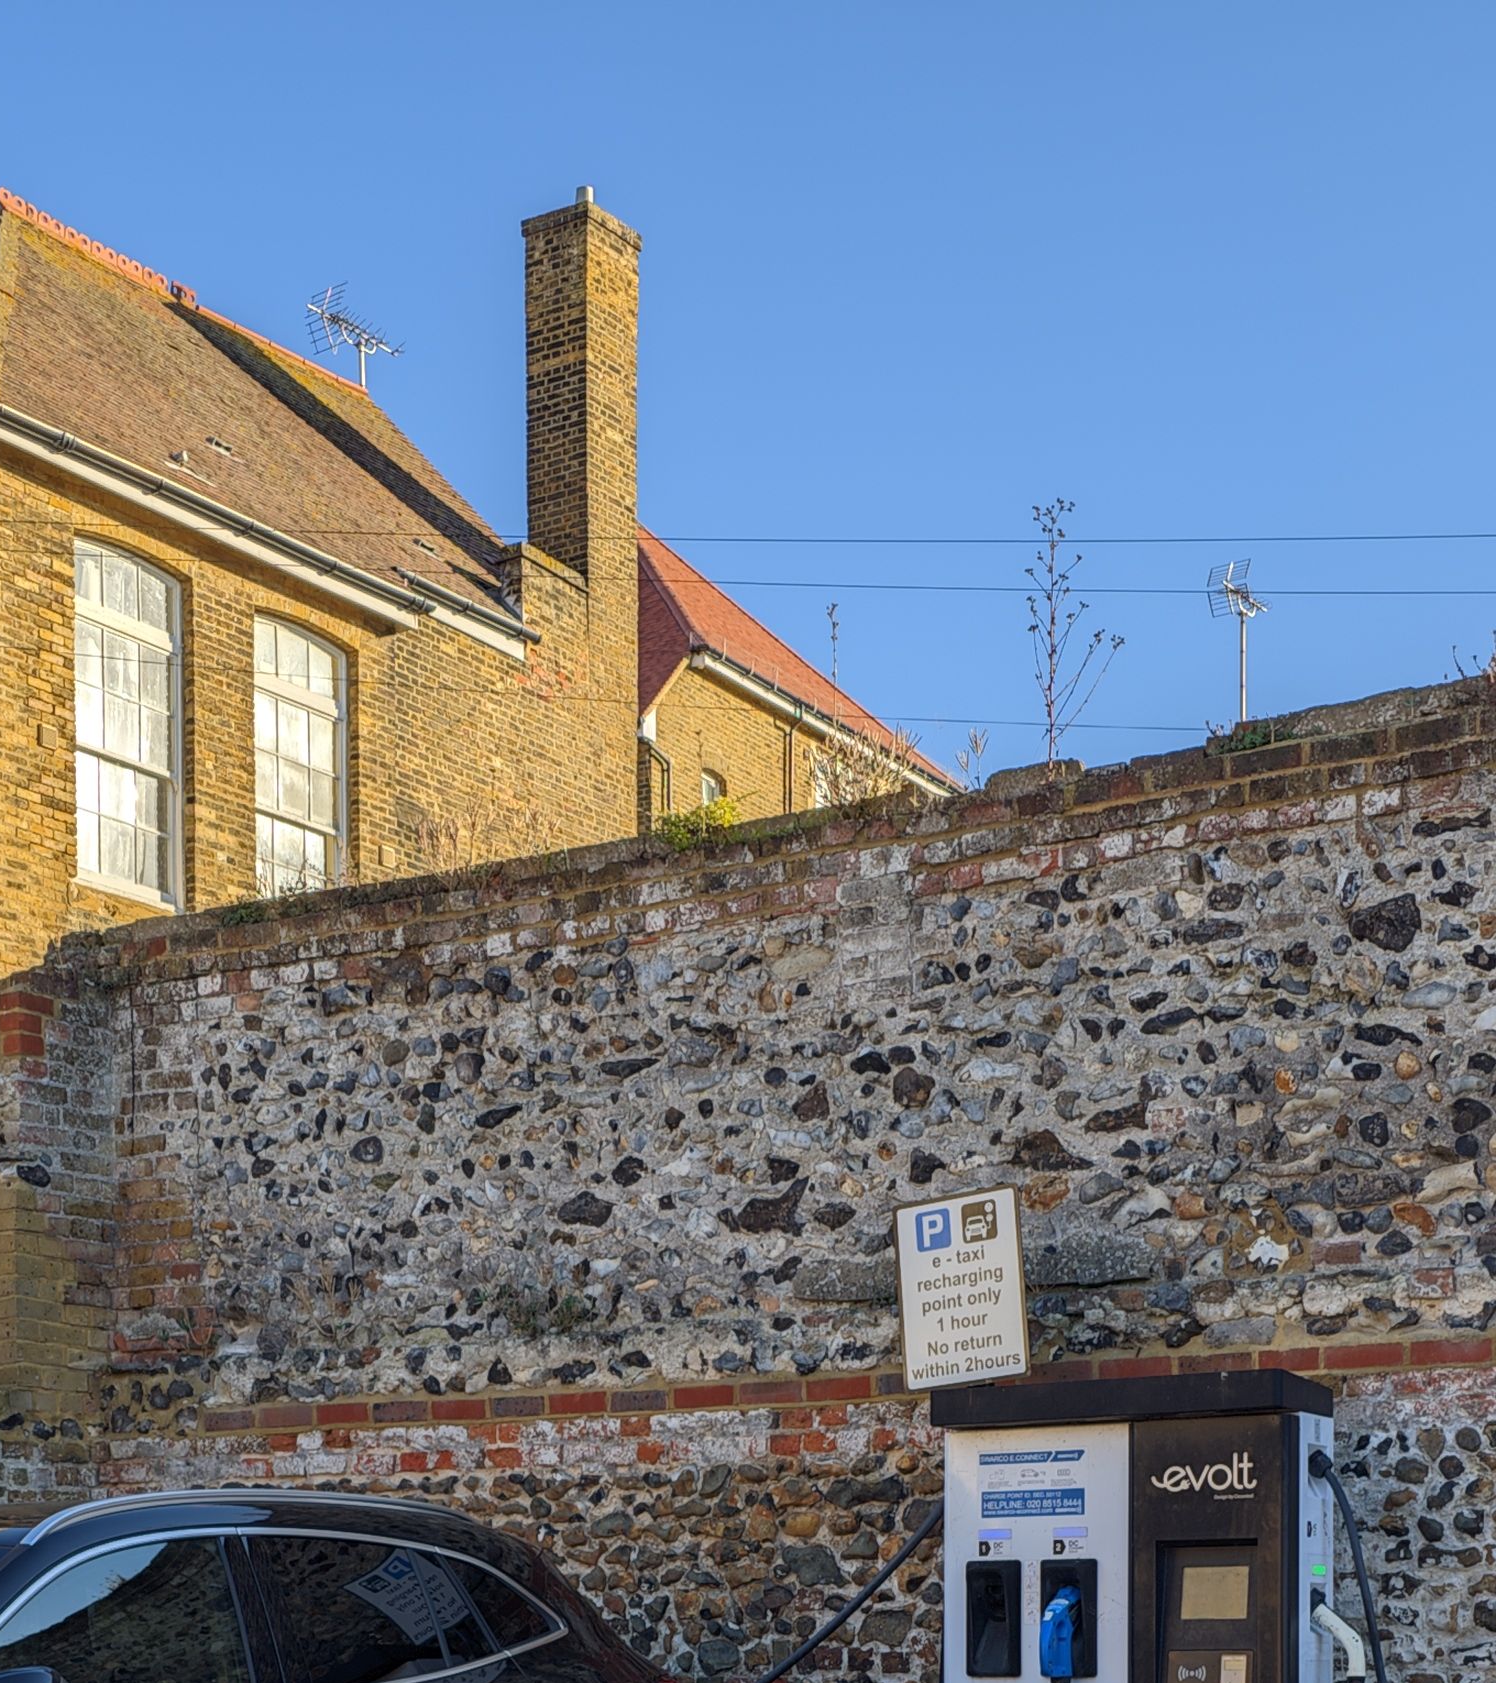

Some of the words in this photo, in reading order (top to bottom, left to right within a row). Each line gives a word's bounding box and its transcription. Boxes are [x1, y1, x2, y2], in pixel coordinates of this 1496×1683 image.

[922, 1215, 944, 1247] P
[932, 1255, 941, 1268] e
[956, 1245, 985, 1264] taxi
[917, 1266, 1004, 1293] recharging
[922, 1291, 962, 1316] point
[967, 1288, 1001, 1310] only
[937, 1318, 944, 1332] 1
[951, 1312, 988, 1330] hour
[927, 1338, 949, 1357] No
[954, 1333, 1002, 1353] return
[912, 1361, 959, 1380] within
[965, 1352, 1021, 1373] 2hours
[1151, 1452, 1257, 1492] evolt
[983, 1500, 1025, 1509] HELPLINE:
[1026, 1500, 1041, 1508] 020
[1042, 1499, 1061, 1508] 8515
[1055, 1543, 1062, 1552] 2
